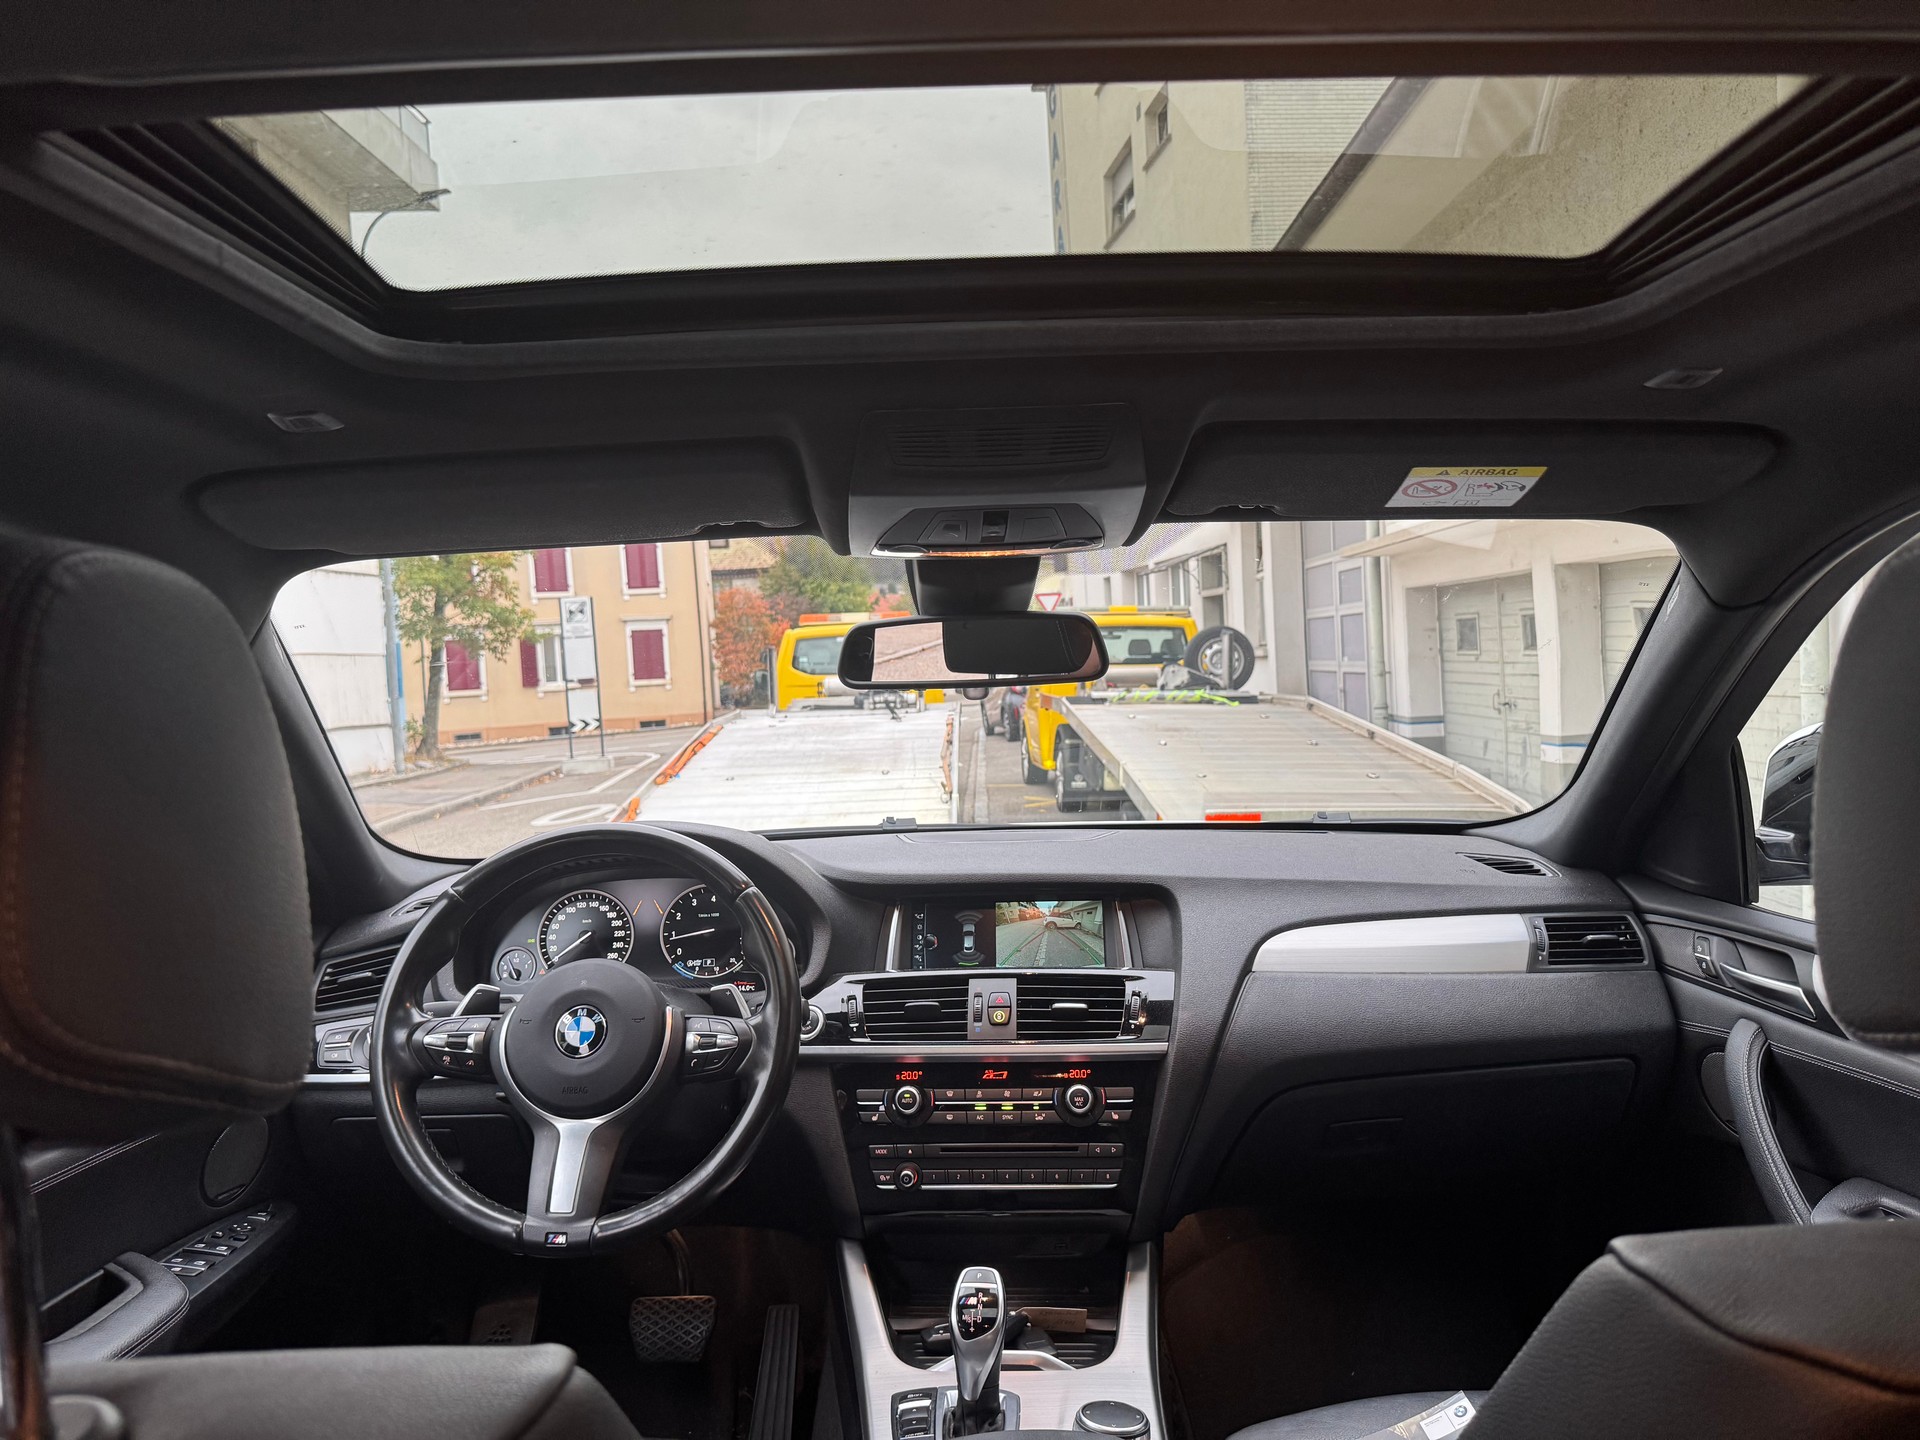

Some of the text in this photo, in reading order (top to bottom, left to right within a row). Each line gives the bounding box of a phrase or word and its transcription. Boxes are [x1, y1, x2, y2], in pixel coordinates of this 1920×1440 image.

[1457, 468, 1519, 476] AIRBAG
[562, 1008, 602, 1024] BMW
[562, 1086, 588, 1095] AIRBAG
